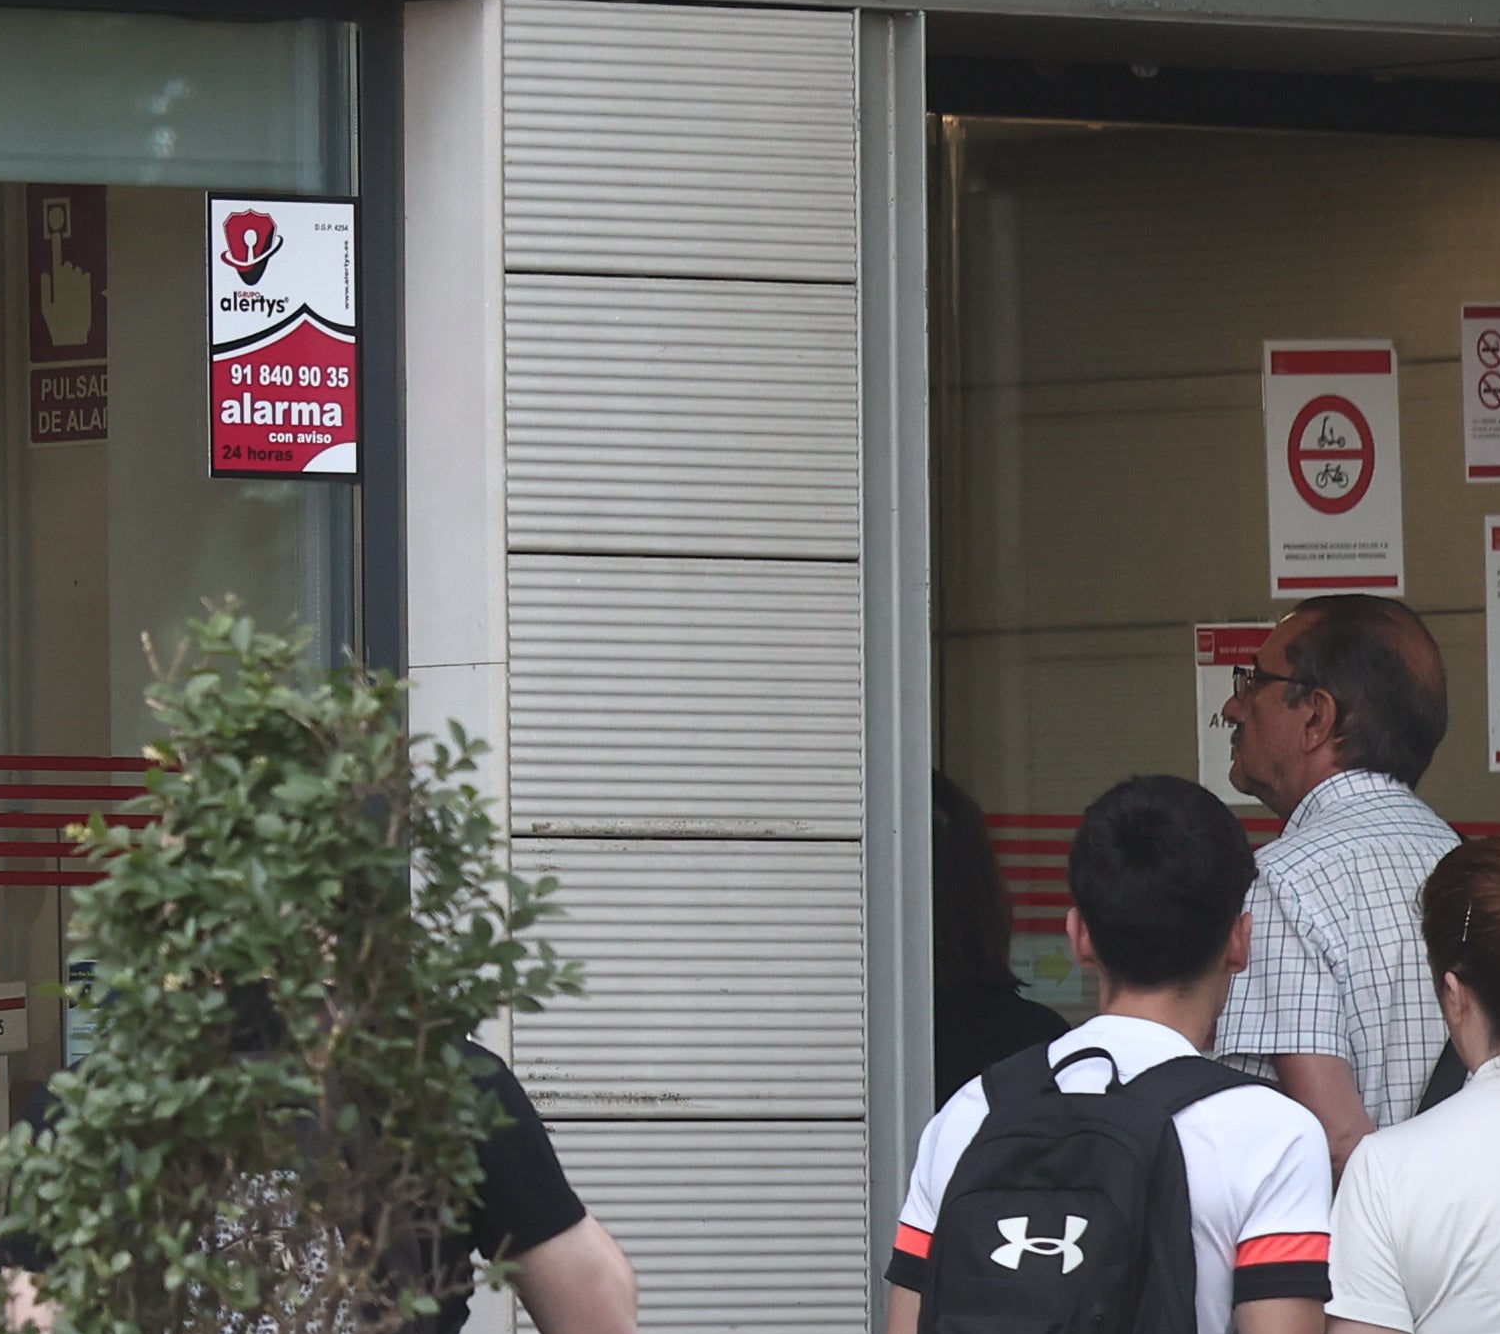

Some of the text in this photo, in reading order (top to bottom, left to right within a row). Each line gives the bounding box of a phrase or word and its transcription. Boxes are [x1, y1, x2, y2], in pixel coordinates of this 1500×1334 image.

[230, 364, 349, 388] 91 840 90 35
[221, 392, 342, 427] alarma
[38, 411, 62, 434] DE
[268, 431, 332, 444] con aviso
[222, 445, 293, 462] 24 horas
